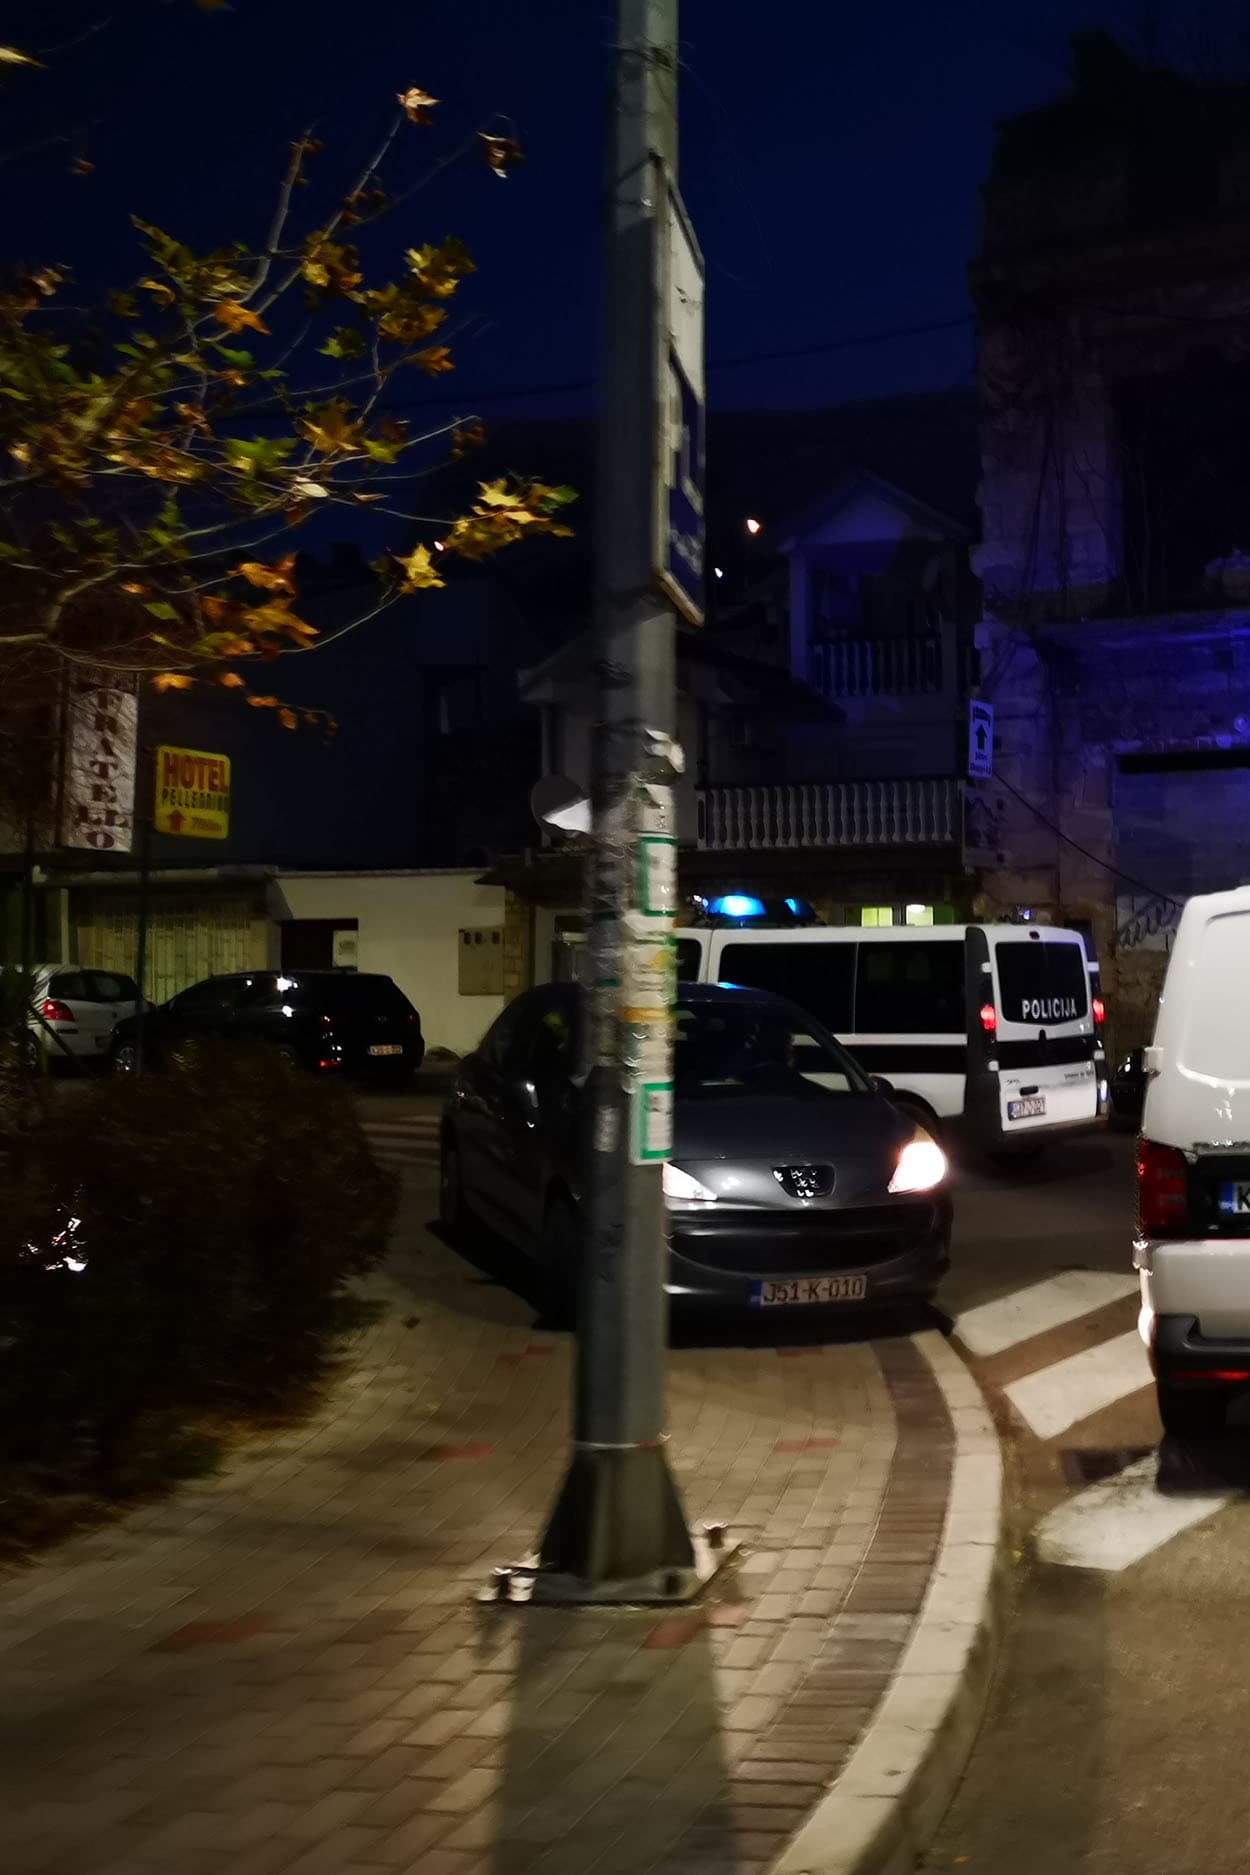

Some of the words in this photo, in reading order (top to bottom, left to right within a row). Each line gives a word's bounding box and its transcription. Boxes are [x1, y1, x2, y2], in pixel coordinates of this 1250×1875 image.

[163, 751, 228, 793] HOTEL
[1022, 998, 1077, 1019] POLICIJA
[763, 1278, 864, 1302] J51-K-010
